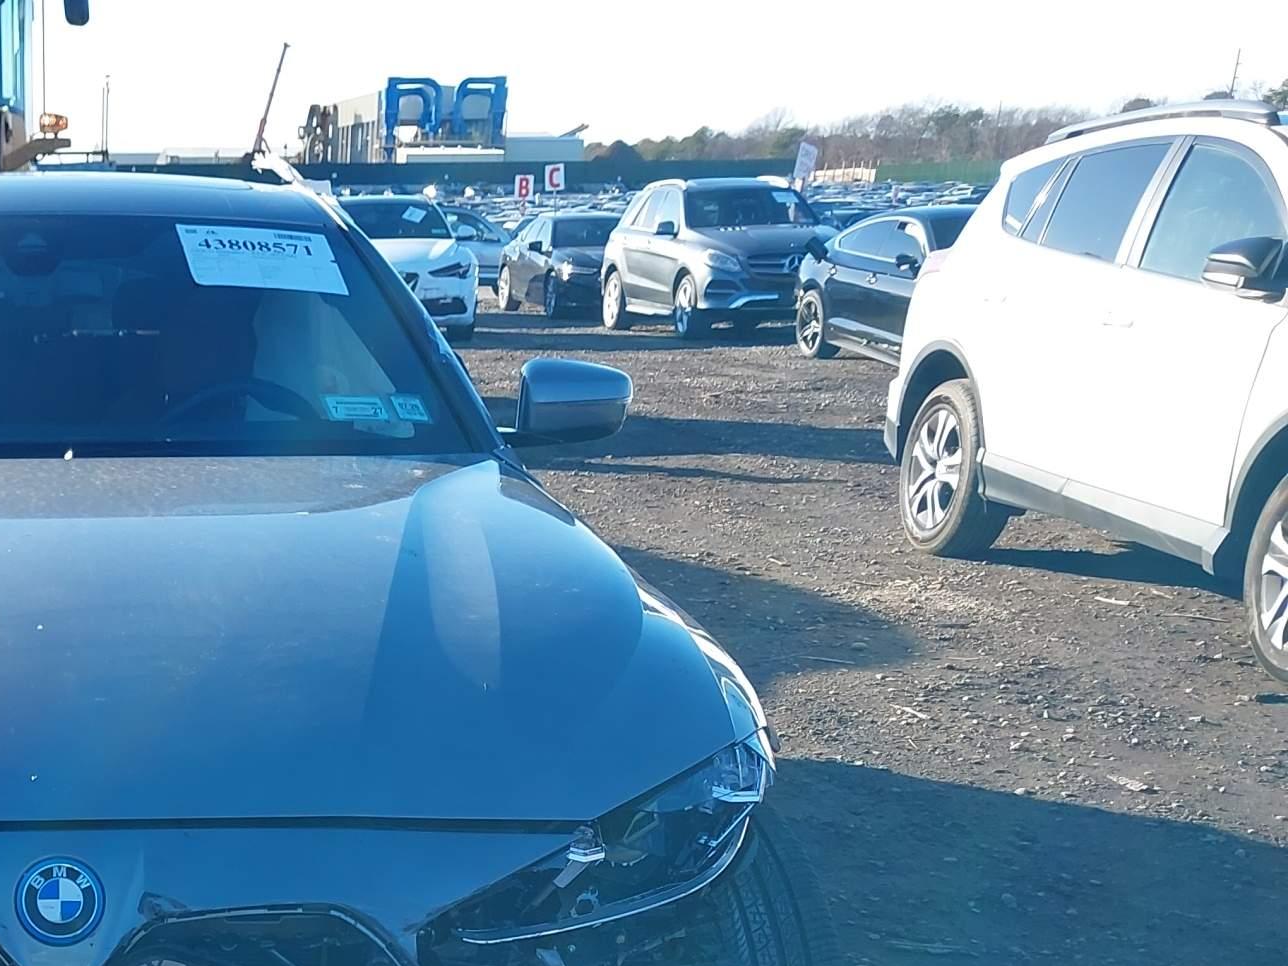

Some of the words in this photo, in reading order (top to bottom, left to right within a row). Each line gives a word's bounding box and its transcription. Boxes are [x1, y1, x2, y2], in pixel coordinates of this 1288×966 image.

[519, 177, 529, 198] B
[549, 167, 560, 188] C
[198, 237, 313, 257] 43808571
[30, 866, 91, 890] BMW
